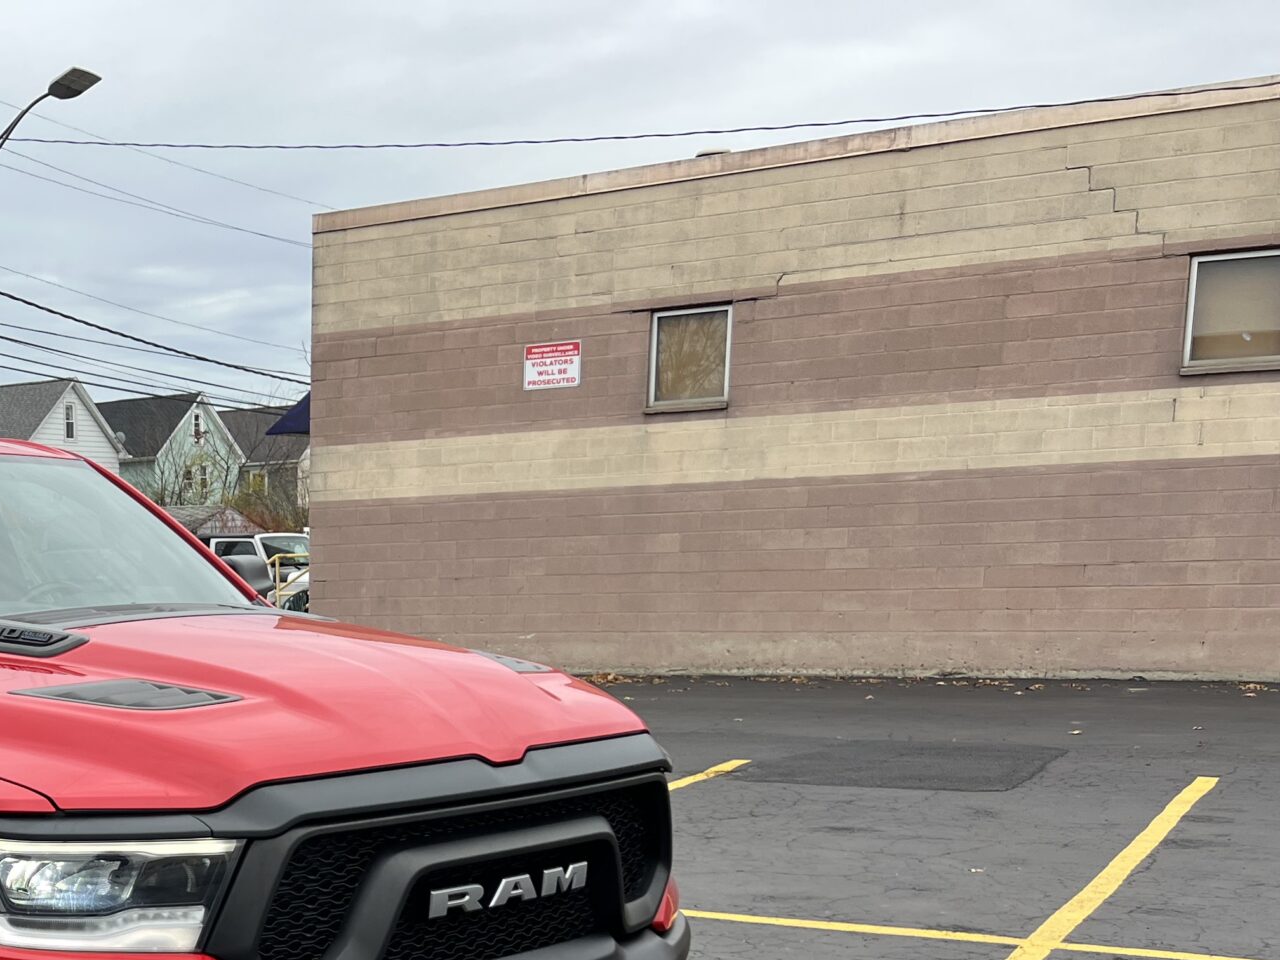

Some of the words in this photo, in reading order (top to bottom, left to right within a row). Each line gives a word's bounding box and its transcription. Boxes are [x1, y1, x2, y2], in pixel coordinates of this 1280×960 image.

[531, 358, 574, 367] VIOLATORS
[527, 377, 576, 386] PROSECUTED
[428, 861, 588, 920] RAM
